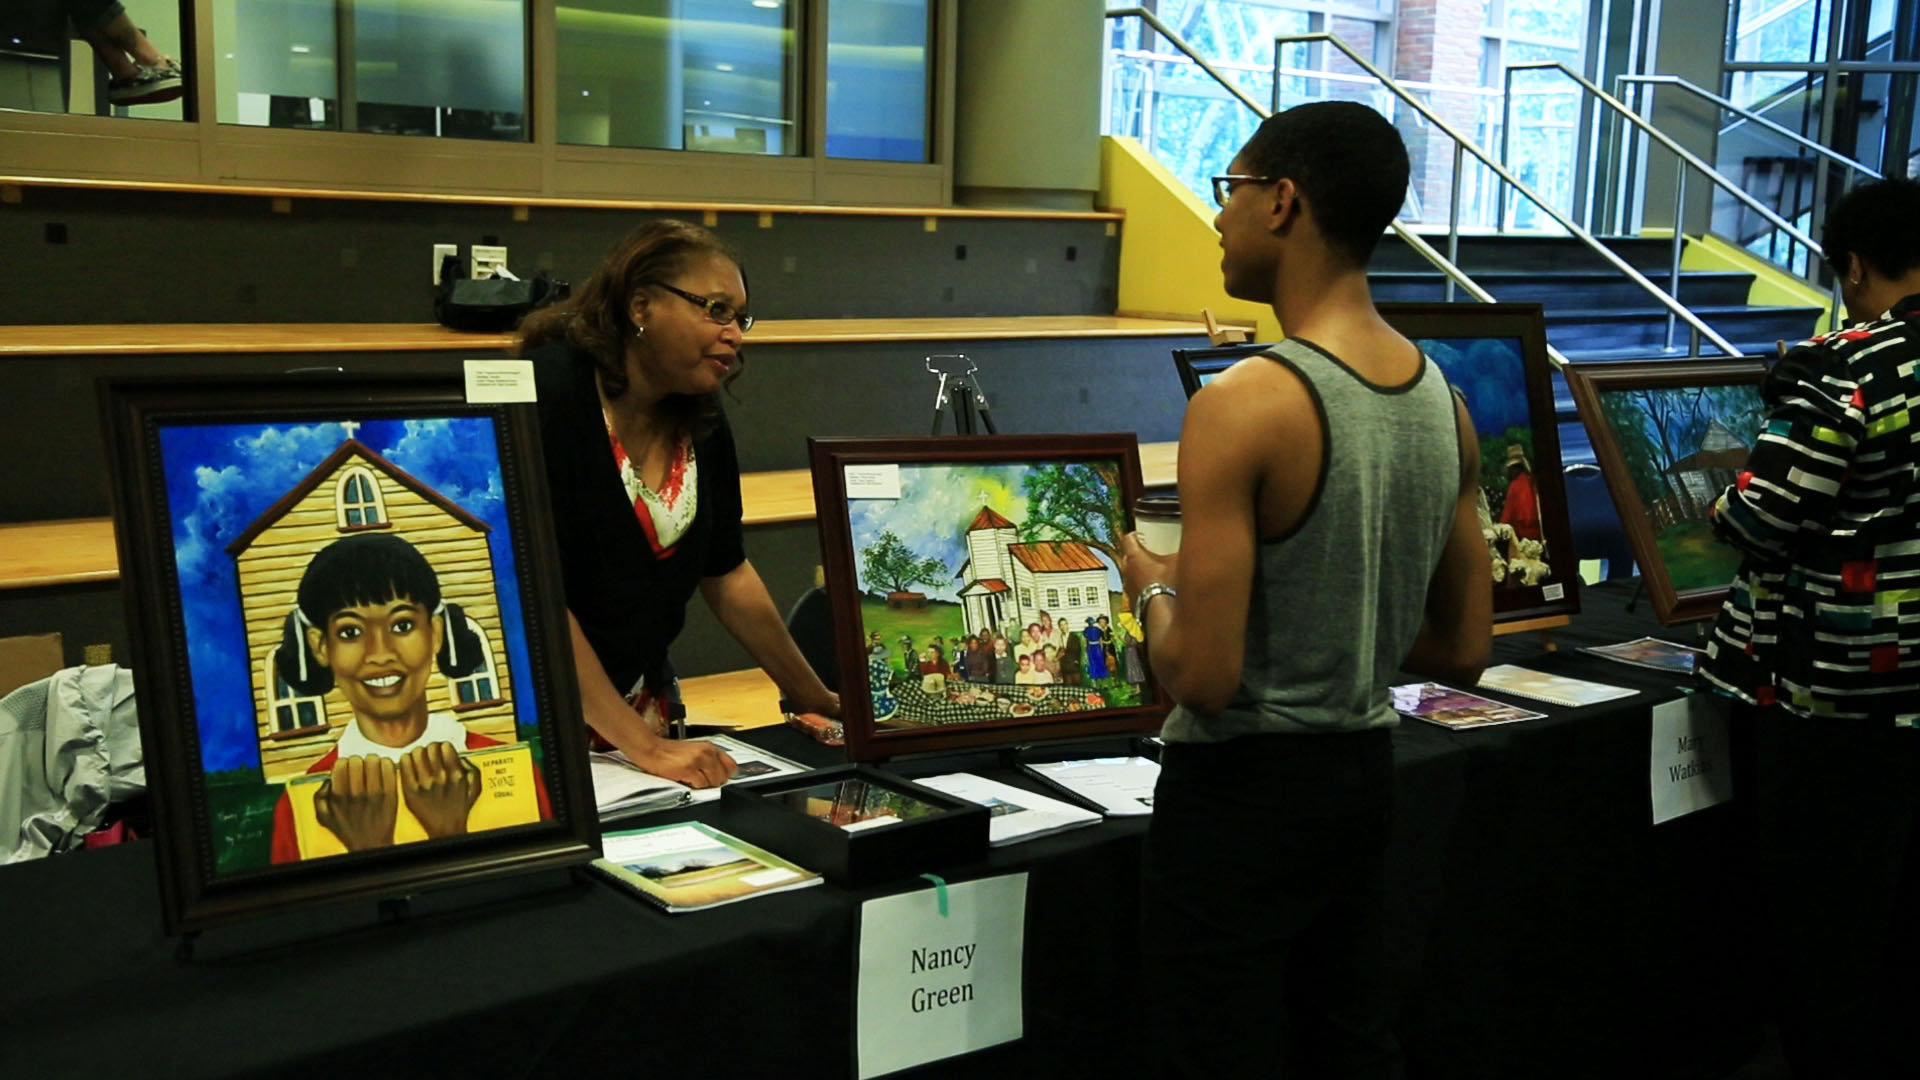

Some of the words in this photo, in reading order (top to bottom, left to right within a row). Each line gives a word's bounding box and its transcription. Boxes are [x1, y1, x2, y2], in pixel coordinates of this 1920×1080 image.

[482, 757, 514, 767] SEPARATE
[911, 943, 976, 974] Nancy
[911, 982, 974, 1013] Green
